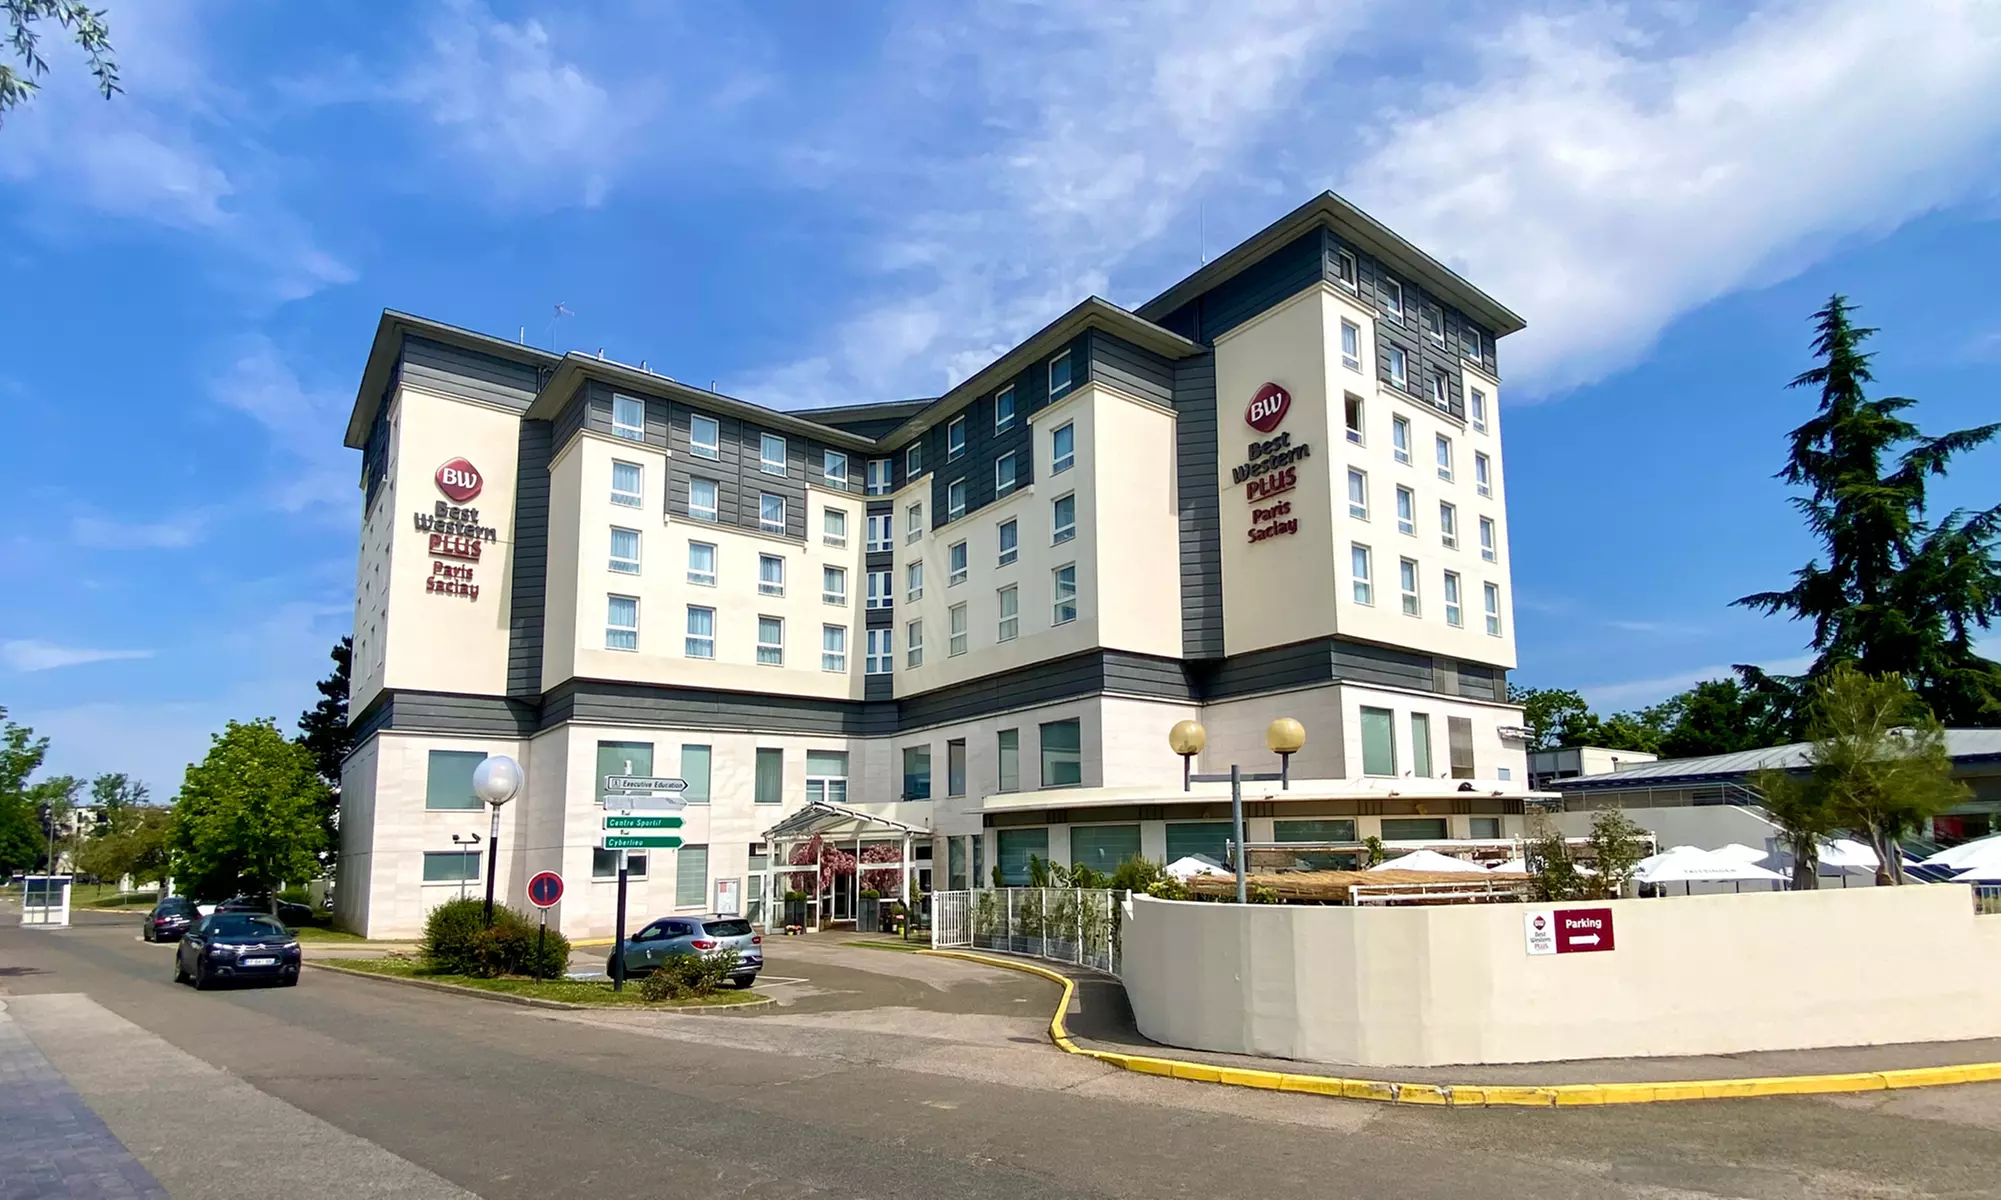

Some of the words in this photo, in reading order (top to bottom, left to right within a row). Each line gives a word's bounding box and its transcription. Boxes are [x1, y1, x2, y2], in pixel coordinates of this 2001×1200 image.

[1251, 393, 1282, 422] BW
[1248, 431, 1291, 461] Best
[1232, 443, 1310, 484] Western
[442, 467, 477, 489] BW
[1246, 466, 1297, 500] PLUS
[435, 500, 479, 523] Best
[1252, 500, 1291, 525] Paris
[413, 512, 497, 542] Western
[1247, 518, 1298, 544] Saclay
[428, 534, 482, 558] PLUS
[432, 561, 474, 581] Paris
[426, 576, 480, 600] Saclay
[622, 780, 652, 788] Executive
[654, 780, 683, 789] Education
[636, 819, 662, 828] Sportif
[608, 839, 643, 847] Cyberlieu
[1565, 917, 1602, 929] Parking
